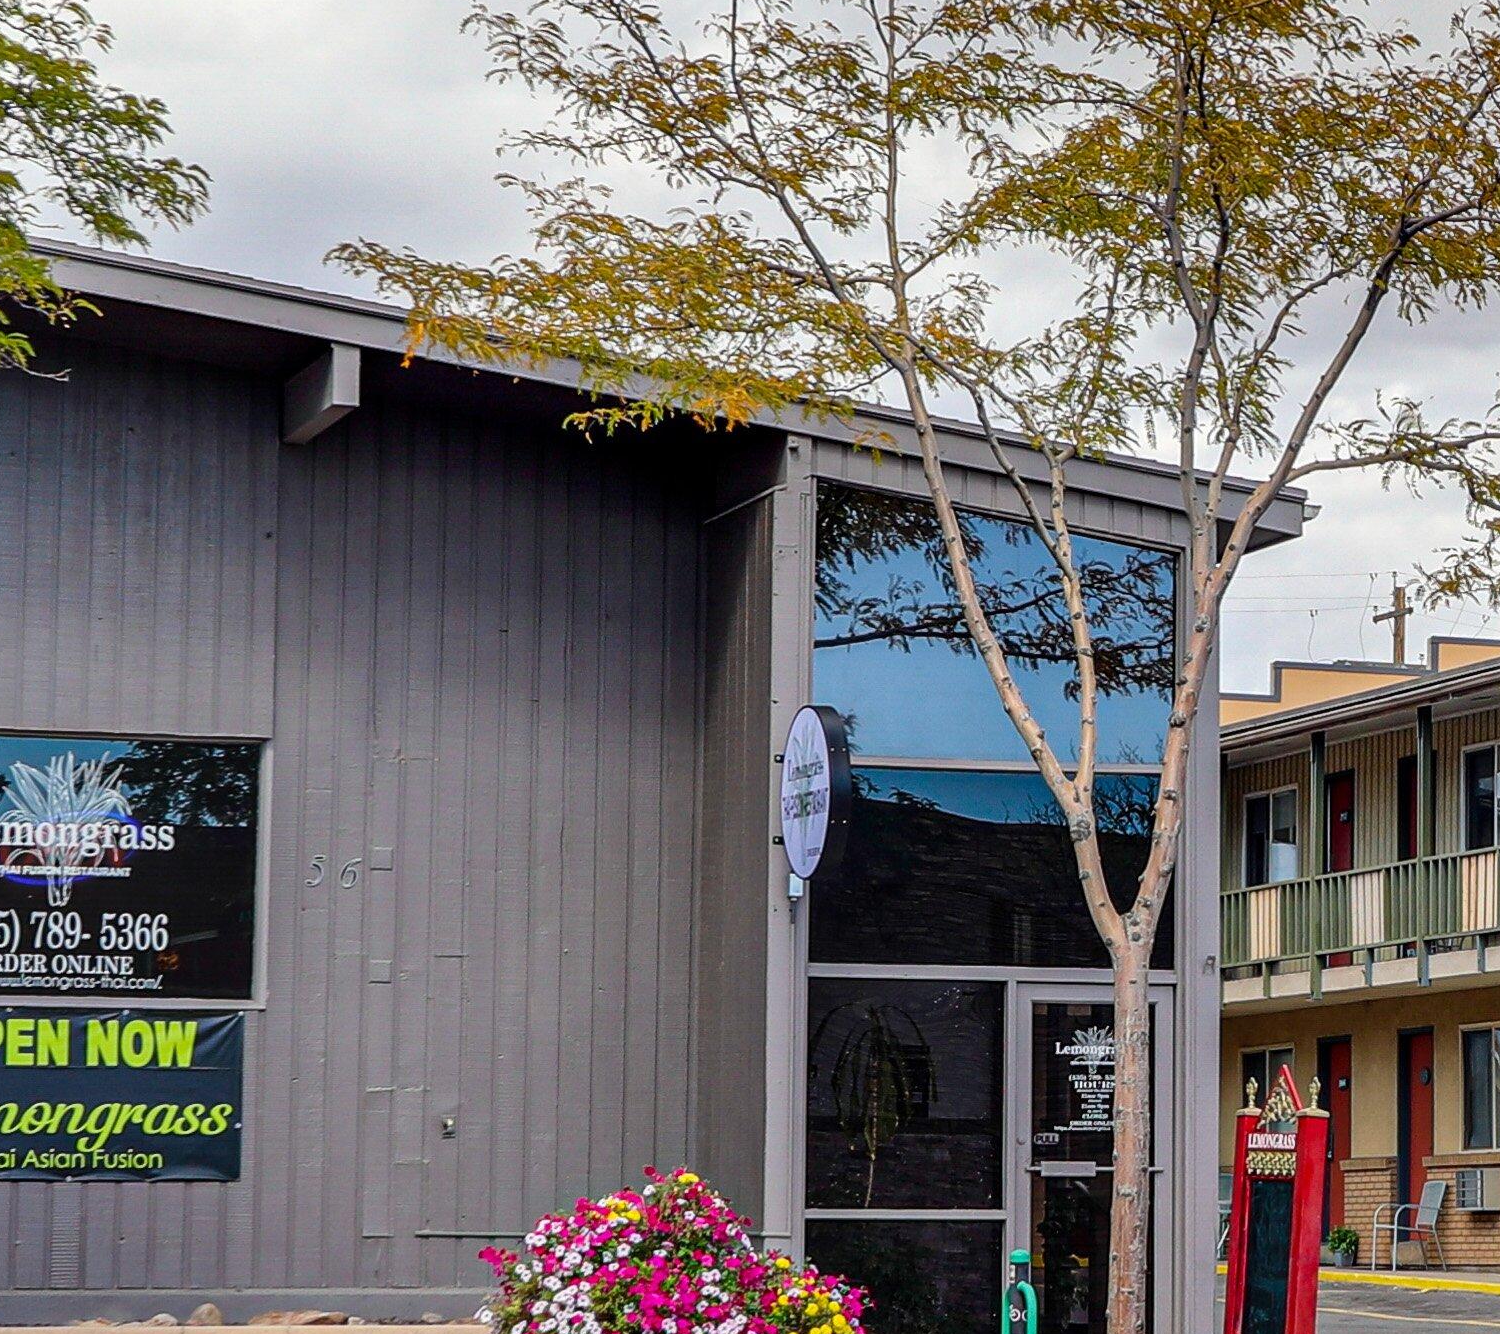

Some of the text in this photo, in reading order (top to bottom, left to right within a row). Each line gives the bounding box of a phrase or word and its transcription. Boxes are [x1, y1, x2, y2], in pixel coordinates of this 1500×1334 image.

[29, 911, 91, 950] 789-
[100, 913, 169, 952] 5366
[51, 955, 134, 975] ONLINE
[86, 1019, 198, 1068] NOW
[1055, 1041, 1115, 1058] Lemongr
[1035, 1135, 1058, 1144] PULL
[1248, 1133, 1297, 1149] LEMONGRASS
[21, 1149, 86, 1168] Asian
[92, 1149, 163, 1168] Fusion
